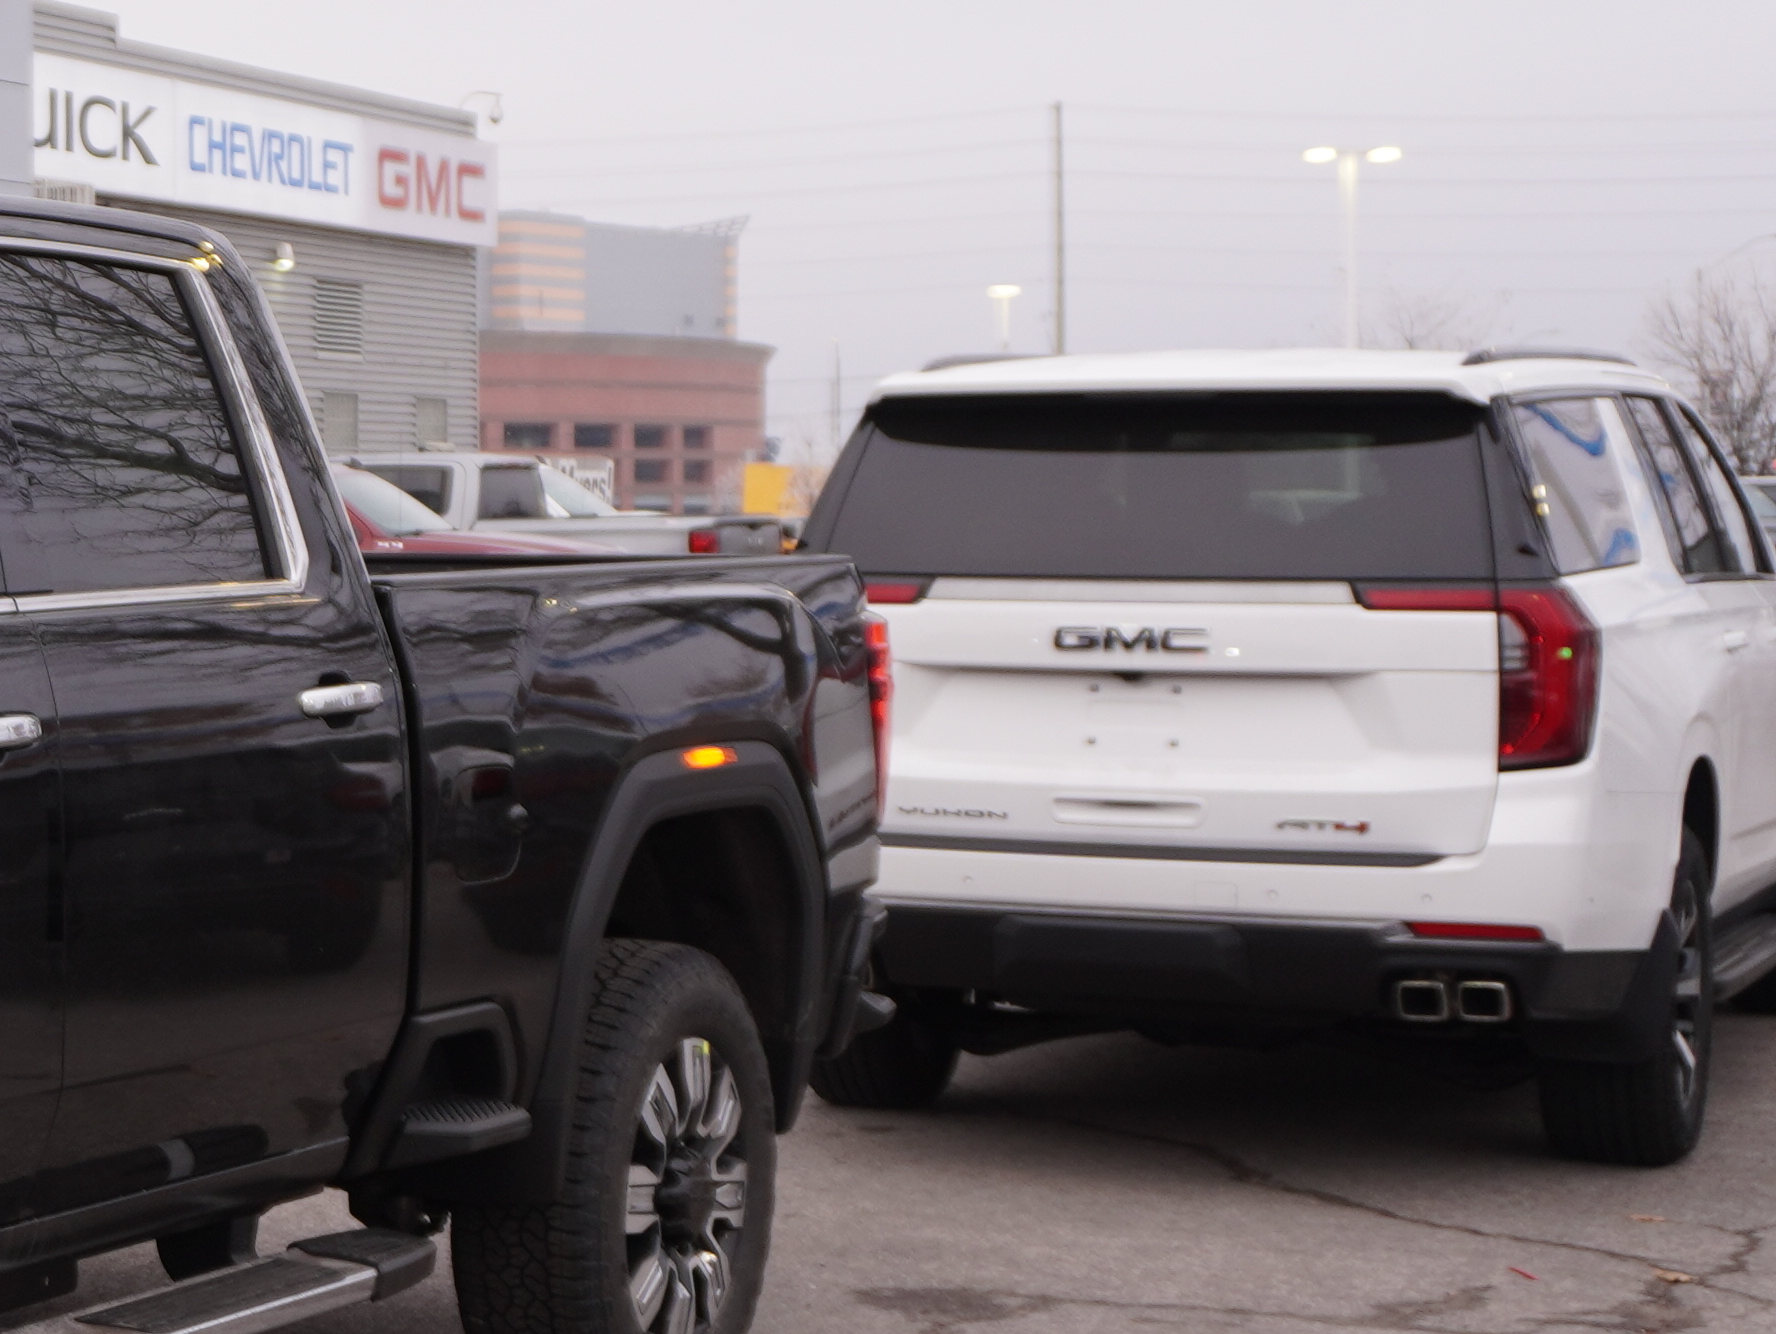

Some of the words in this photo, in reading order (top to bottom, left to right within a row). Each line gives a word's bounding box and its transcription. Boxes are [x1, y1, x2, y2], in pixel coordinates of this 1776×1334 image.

[34, 87, 160, 167] UICK
[188, 113, 355, 197] CHEVROLET
[376, 145, 488, 223] GMC
[1053, 626, 1211, 654] GMC
[898, 805, 1009, 821] YUKON
[1275, 818, 1371, 836] AT4
